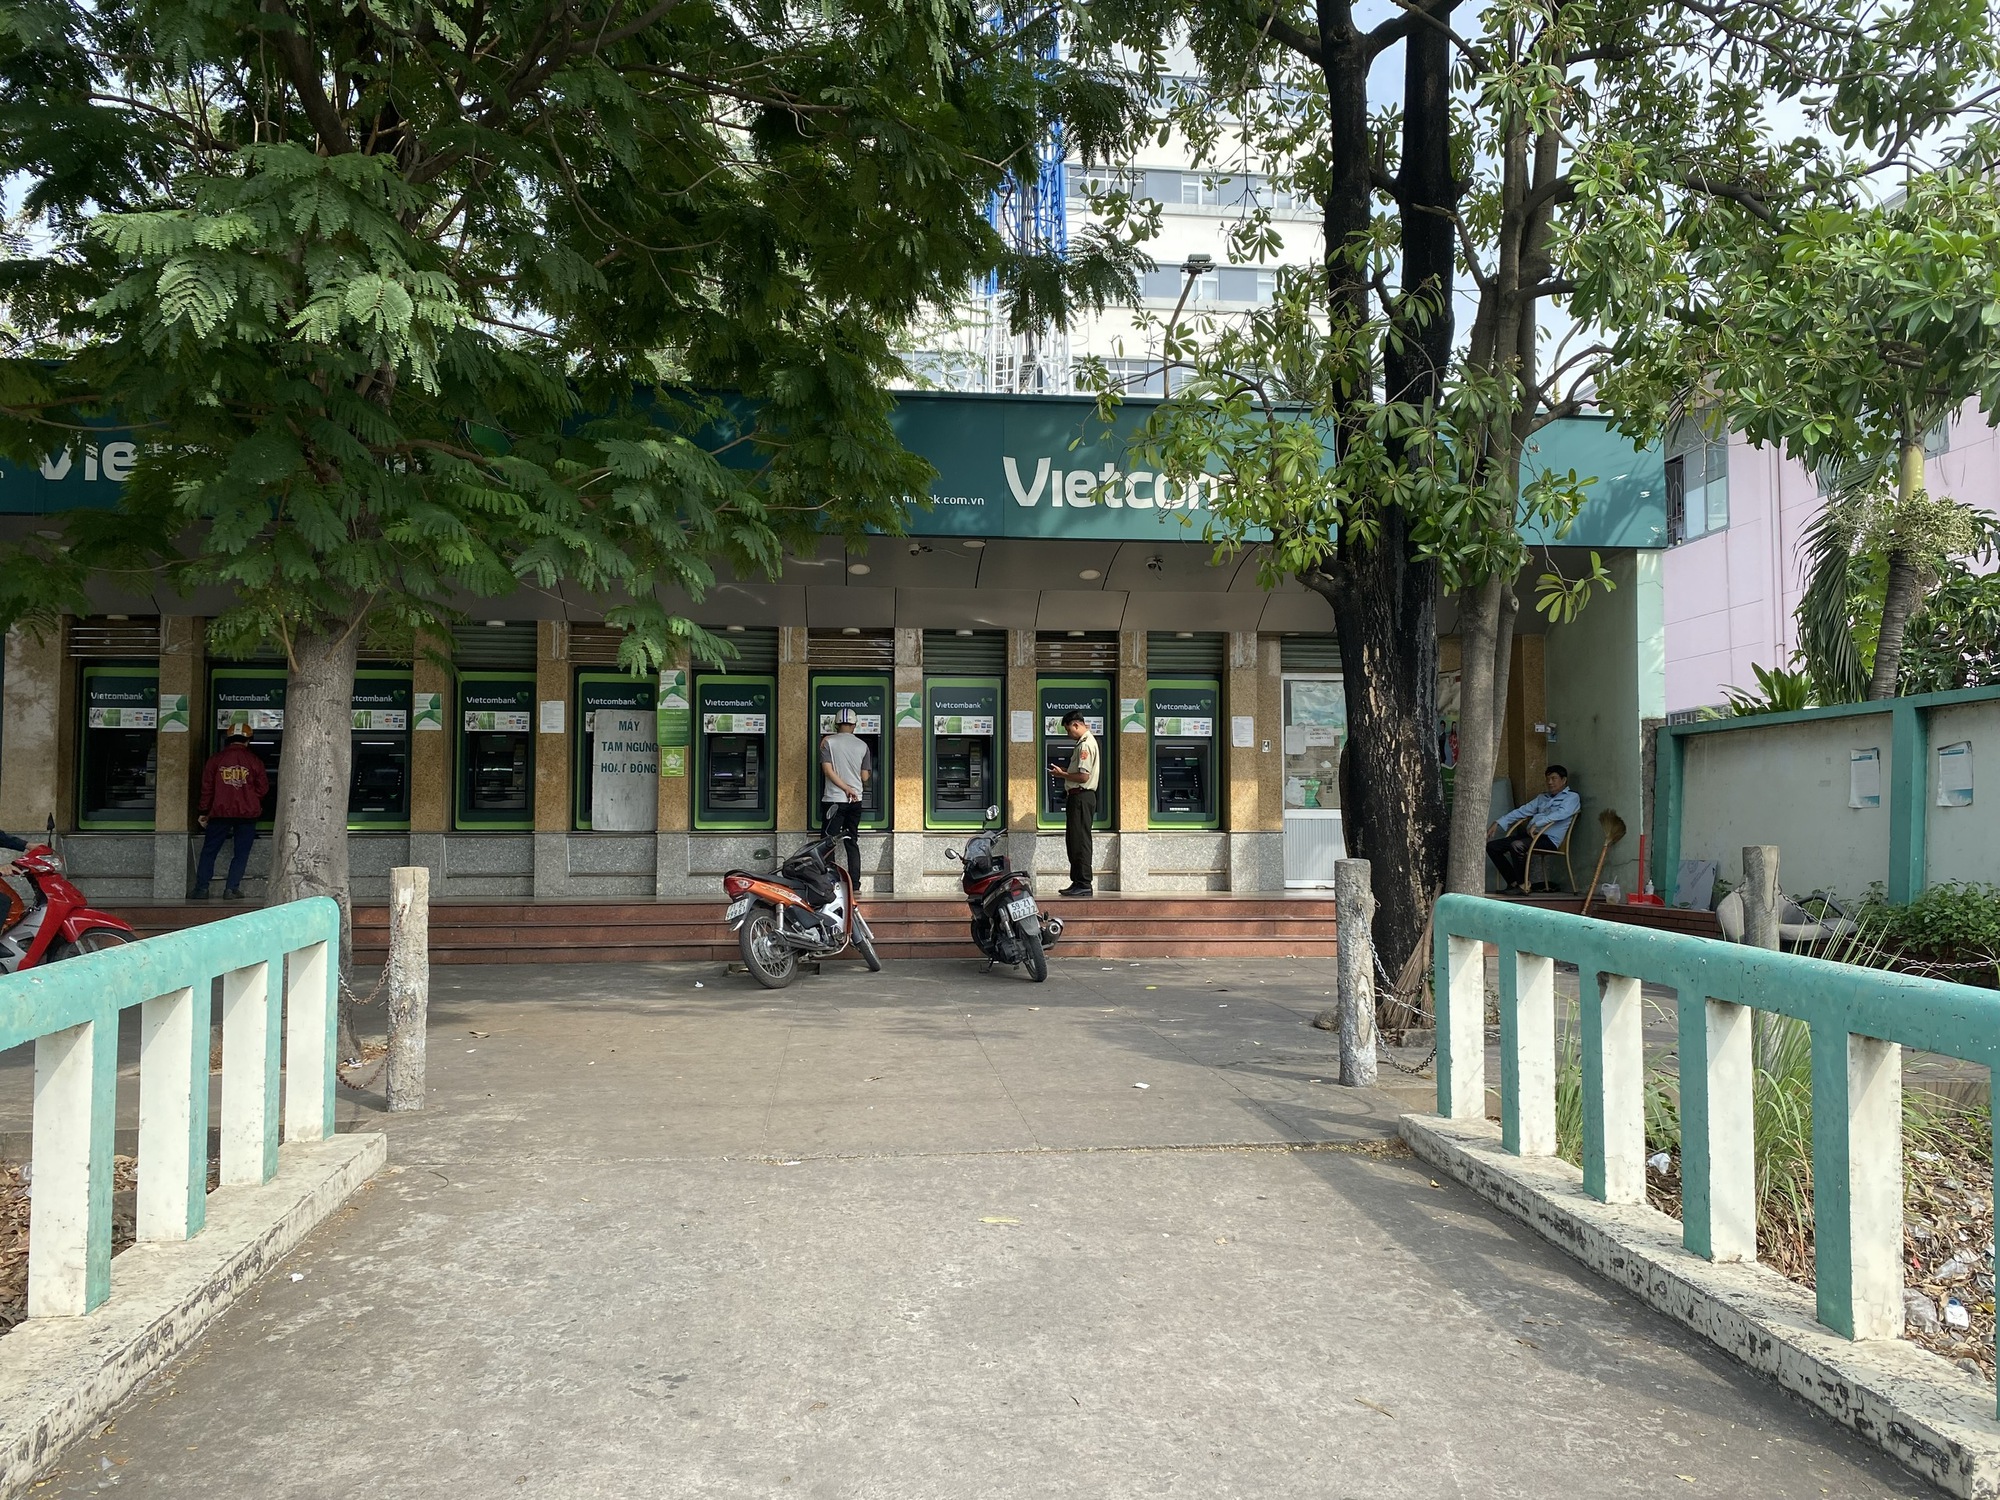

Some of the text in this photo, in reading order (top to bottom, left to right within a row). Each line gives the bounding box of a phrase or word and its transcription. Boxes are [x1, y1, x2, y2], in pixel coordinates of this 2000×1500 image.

[91, 692, 143, 700] Vietcombank
[219, 693, 271, 702] Vietcombank
[352, 694, 393, 702] etcombank
[466, 697, 517, 705] Vietcombank
[586, 697, 637, 706] Vietcombank
[705, 699, 754, 707] Vietcombank
[821, 700, 869, 708] Vietcombank
[935, 701, 982, 709] Vietcombank
[1046, 702, 1092, 710] Vietcombank
[1155, 703, 1201, 711] Vietcombank
[618, 718, 640, 732] MÁY
[601, 741, 622, 755] TẠM
[630, 761, 657, 777] ĐỘNG
